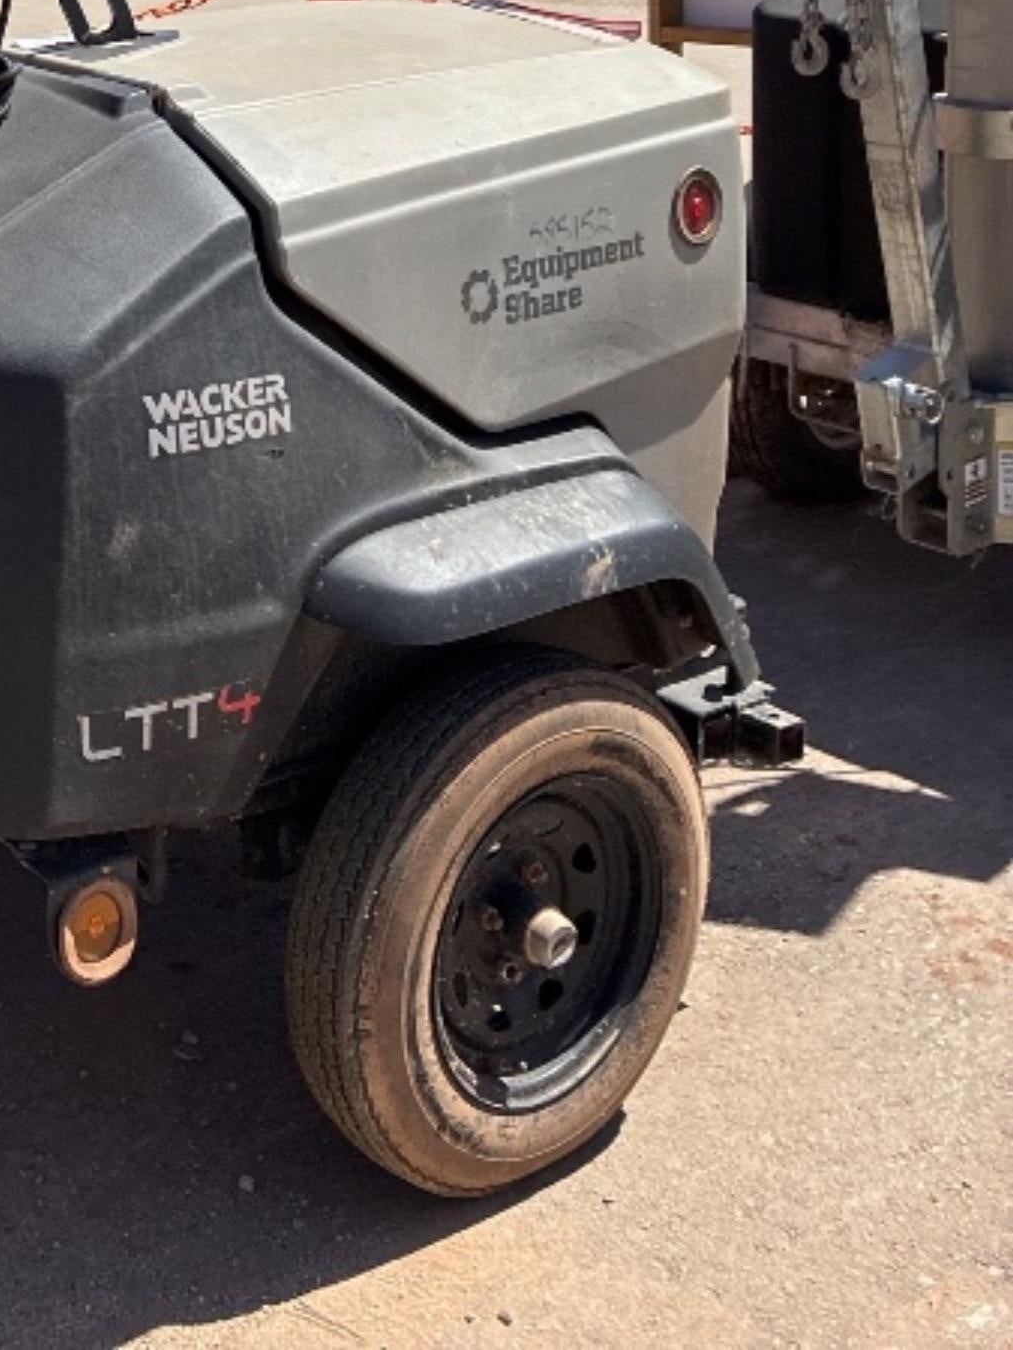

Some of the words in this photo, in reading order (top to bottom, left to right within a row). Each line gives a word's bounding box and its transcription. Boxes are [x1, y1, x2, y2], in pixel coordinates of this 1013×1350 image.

[502, 231, 645, 289] Equipment
[505, 284, 583, 325] Share
[142, 374, 290, 424] WACKER
[148, 403, 291, 459] NEUSON
